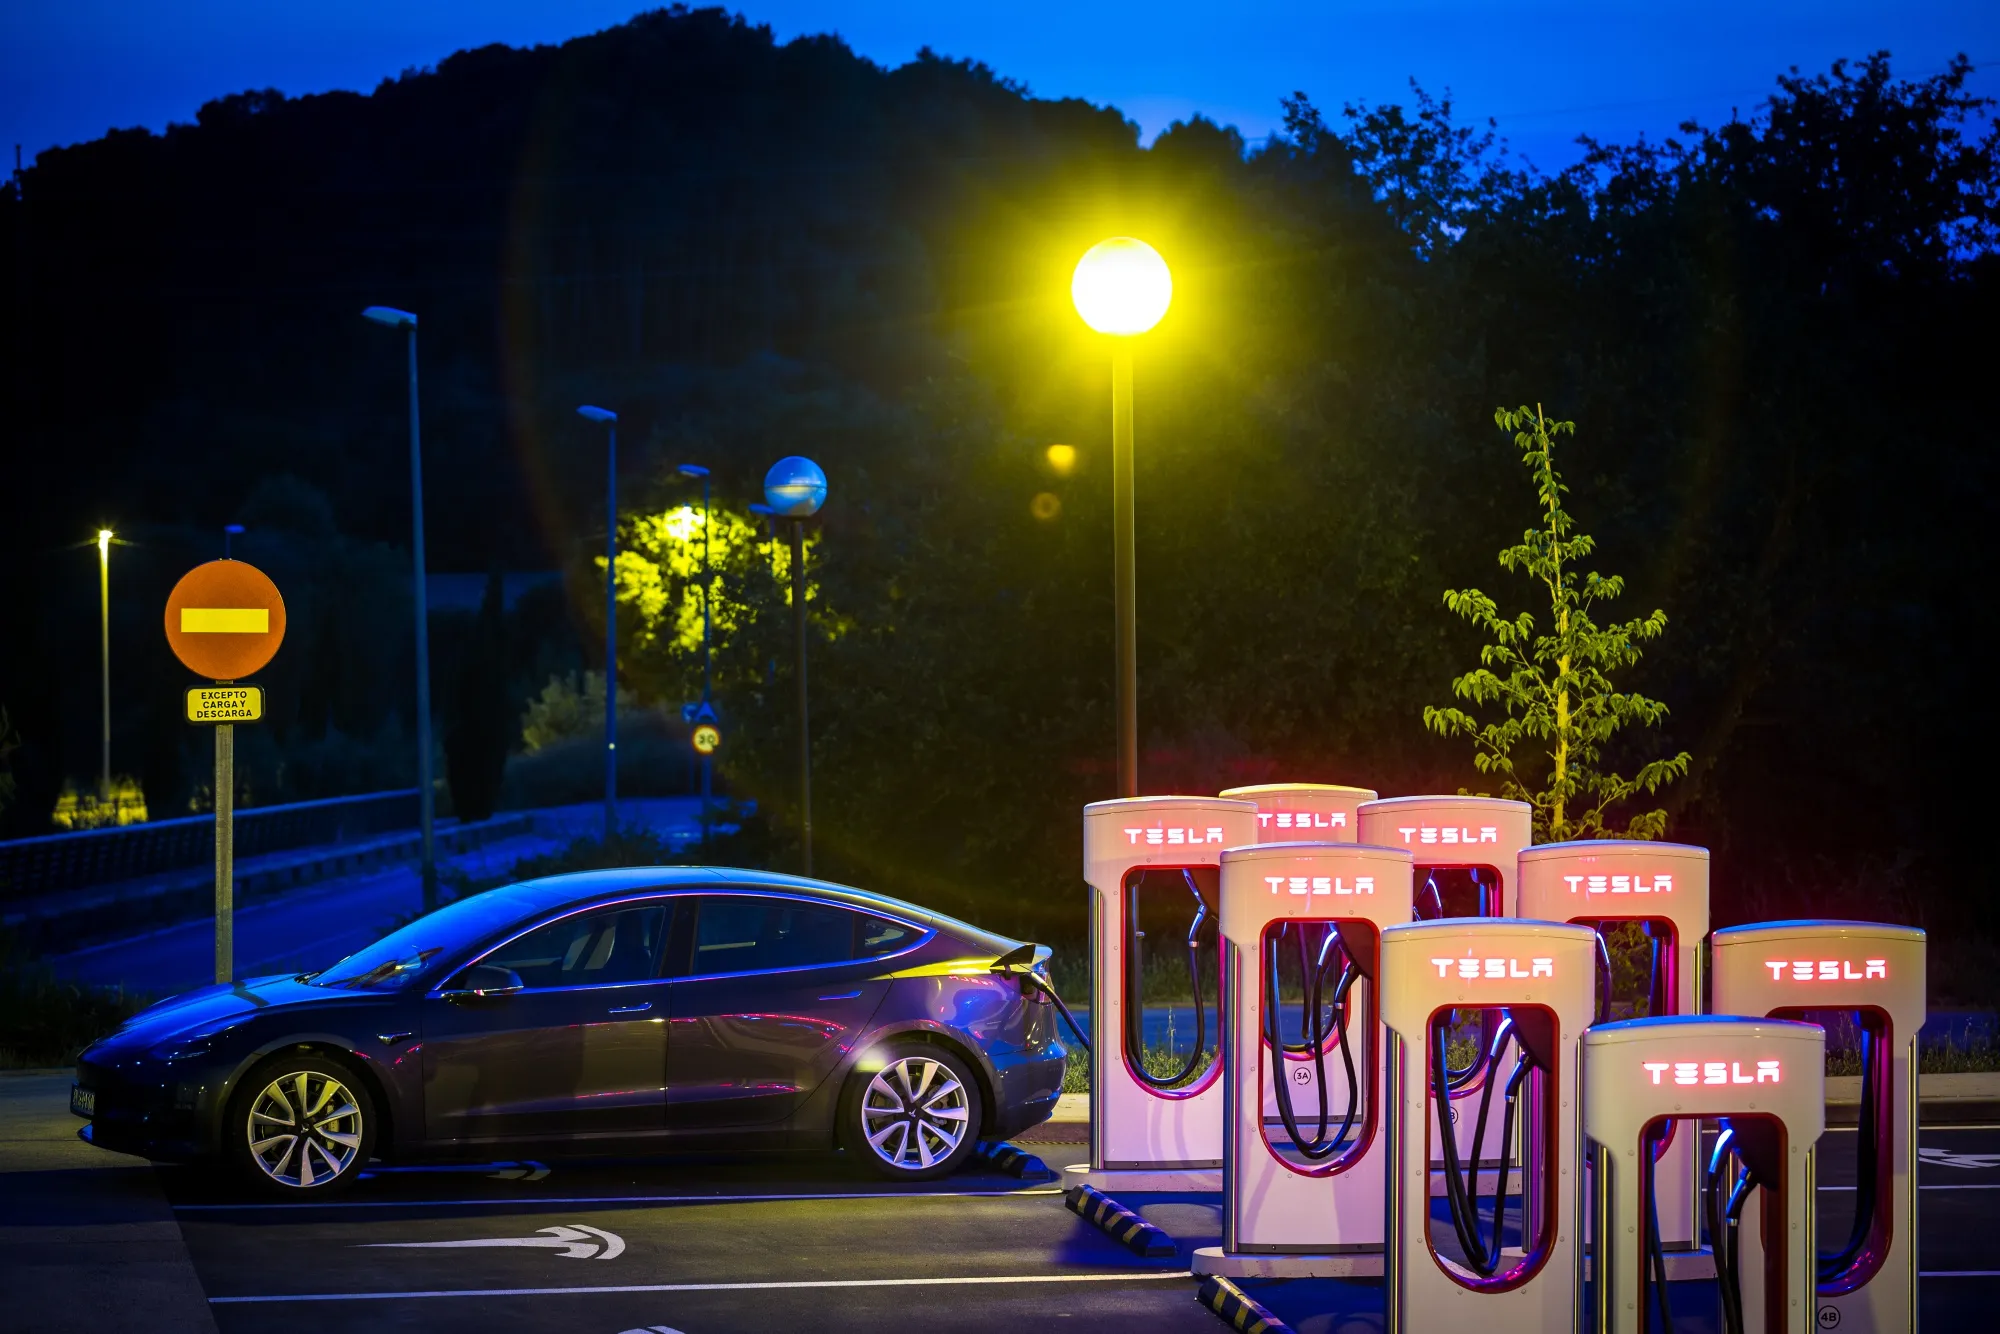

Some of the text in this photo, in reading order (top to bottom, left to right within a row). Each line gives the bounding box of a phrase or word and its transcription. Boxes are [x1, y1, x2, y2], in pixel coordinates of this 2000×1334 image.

[201, 691, 247, 700] EXCEPTO
[203, 700, 246, 709] CARGA Y
[197, 709, 252, 718] DESCARGA
[699, 734, 715, 746] 30
[1257, 812, 1346, 828] TESLA
[1124, 827, 1223, 845] TESLA
[1398, 827, 1497, 844] TESLA
[1264, 876, 1374, 895] TESLA
[1563, 875, 1672, 893] TESLA
[1431, 957, 1553, 978] TESLA
[1765, 959, 1886, 981] TESLA
[1296, 1072, 1309, 1080] 3A
[1643, 1060, 1780, 1085] TESLA
[1820, 1312, 1837, 1322] 4B
